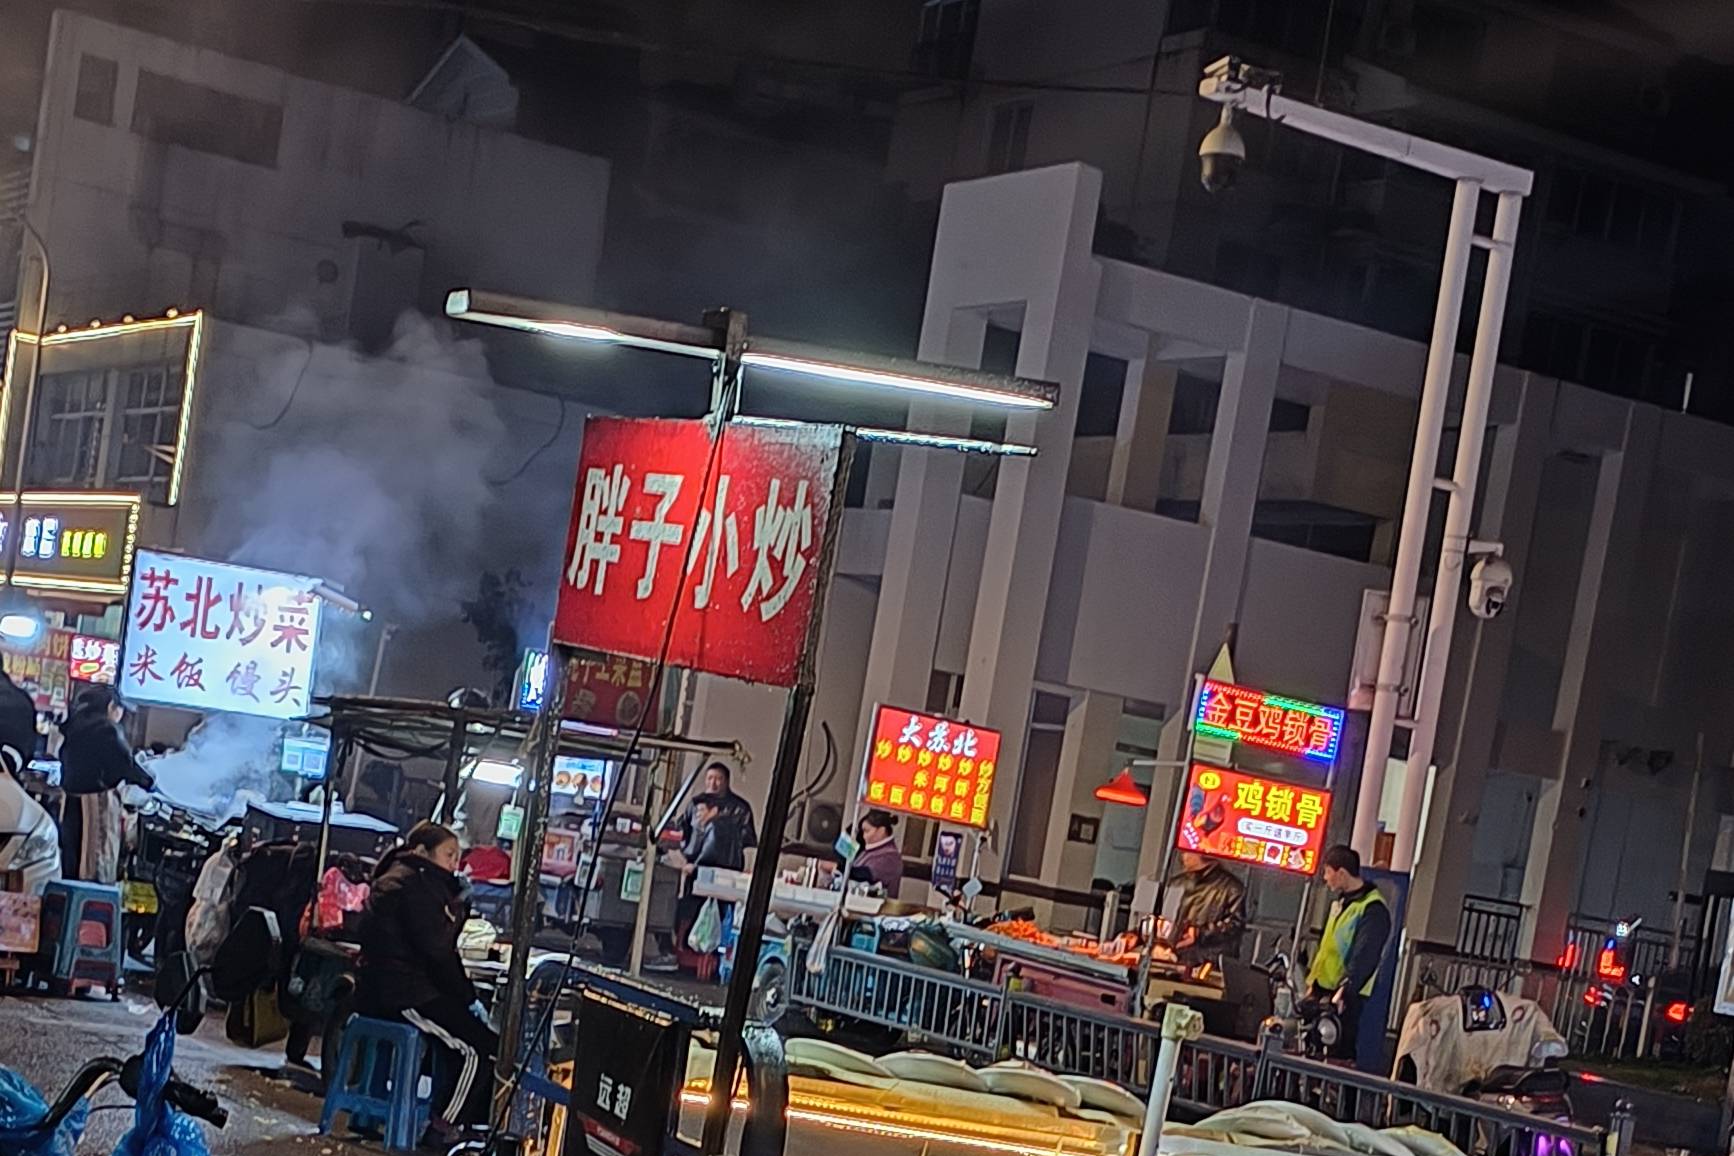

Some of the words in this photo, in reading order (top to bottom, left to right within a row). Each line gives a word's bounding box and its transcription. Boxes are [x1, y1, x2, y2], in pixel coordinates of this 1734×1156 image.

[567, 463, 813, 623] 胖子小炒
[134, 567, 315, 655] 苏北炒菜
[129, 643, 207, 692] 米饭
[226, 660, 303, 708] 馒头
[899, 715, 978, 757] 大苏北
[1205, 691, 1332, 751] 金豆鸡锁骨
[1234, 780, 1323, 829] 鸡锁骨
